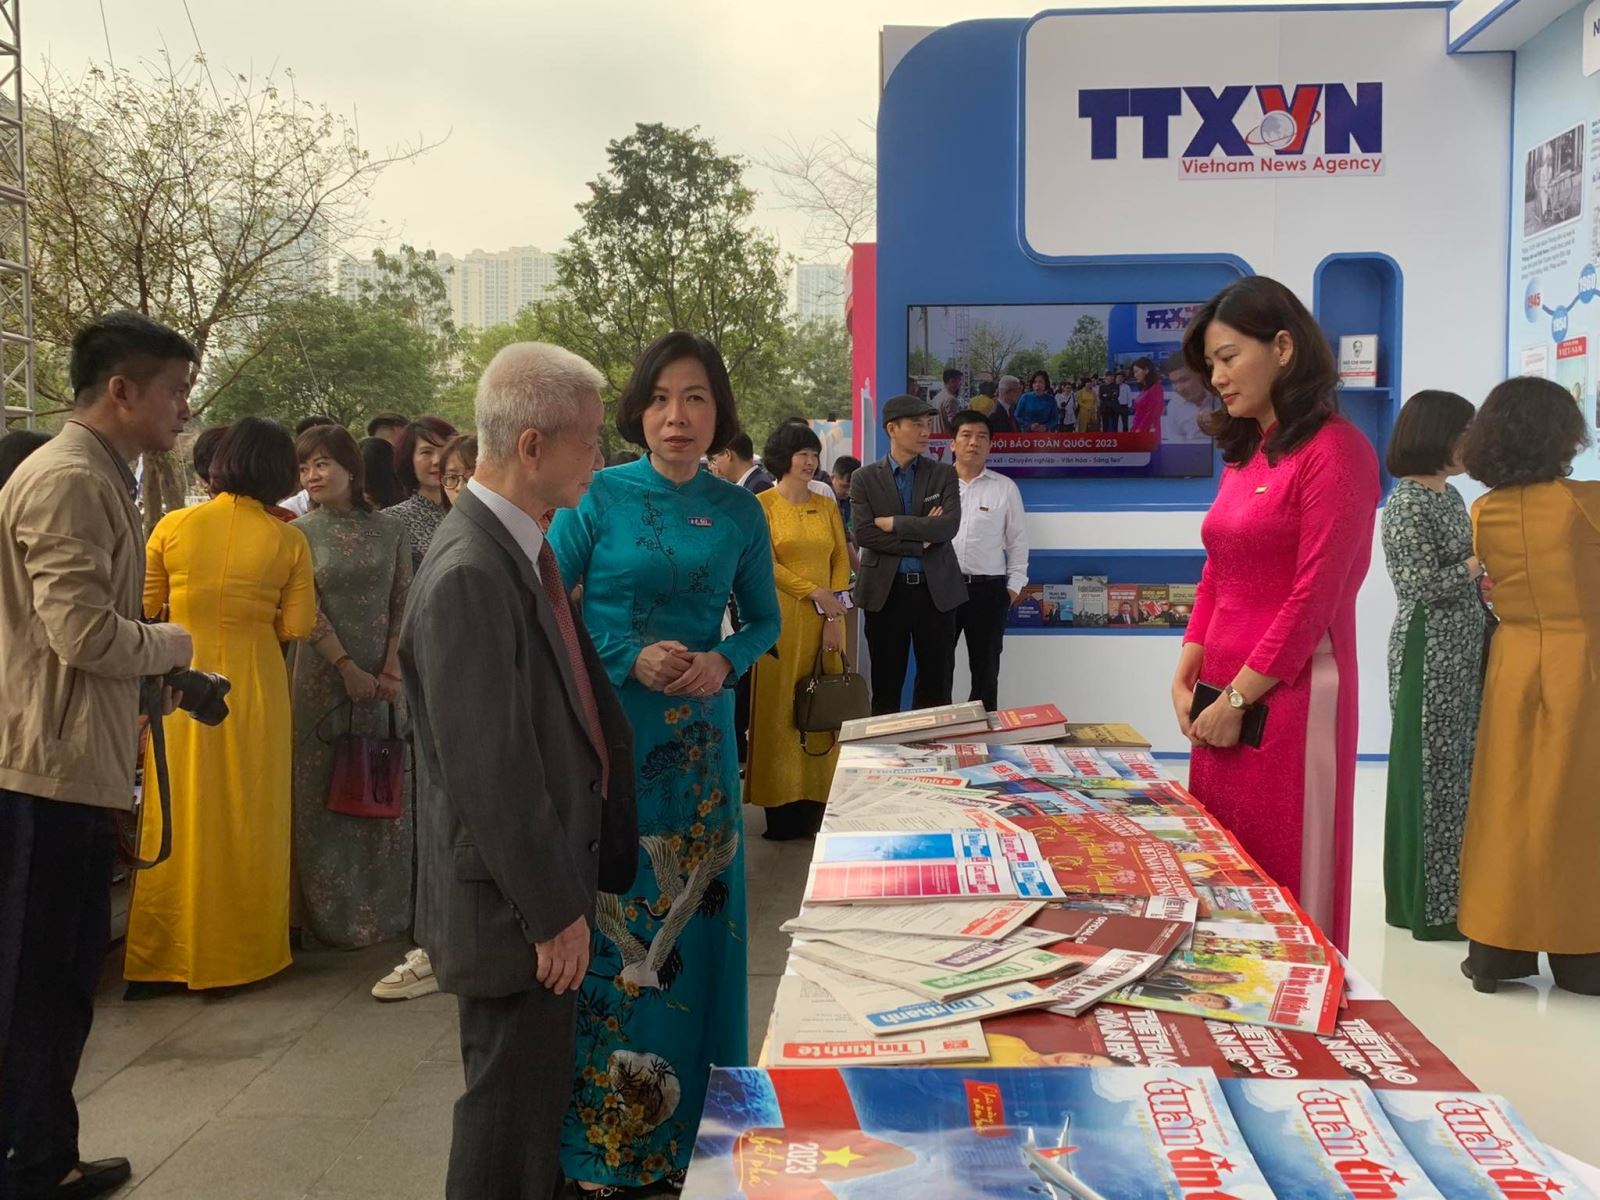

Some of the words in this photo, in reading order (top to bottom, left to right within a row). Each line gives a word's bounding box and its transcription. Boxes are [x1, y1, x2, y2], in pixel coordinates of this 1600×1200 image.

[1078, 82, 1383, 160] TTXVN
[1182, 156, 1255, 174] Vietnam
[1260, 156, 1307, 172] News
[1312, 156, 1382, 174] Agency
[1095, 438, 1118, 448] 2023
[880, 1004, 946, 1023] nhanh
[824, 1043, 872, 1056] kinh
[877, 1042, 909, 1056] Tin
[1244, 1037, 1299, 1078] THAO
[1358, 1040, 1419, 1085] THAO
[785, 1142, 819, 1174] 2023
